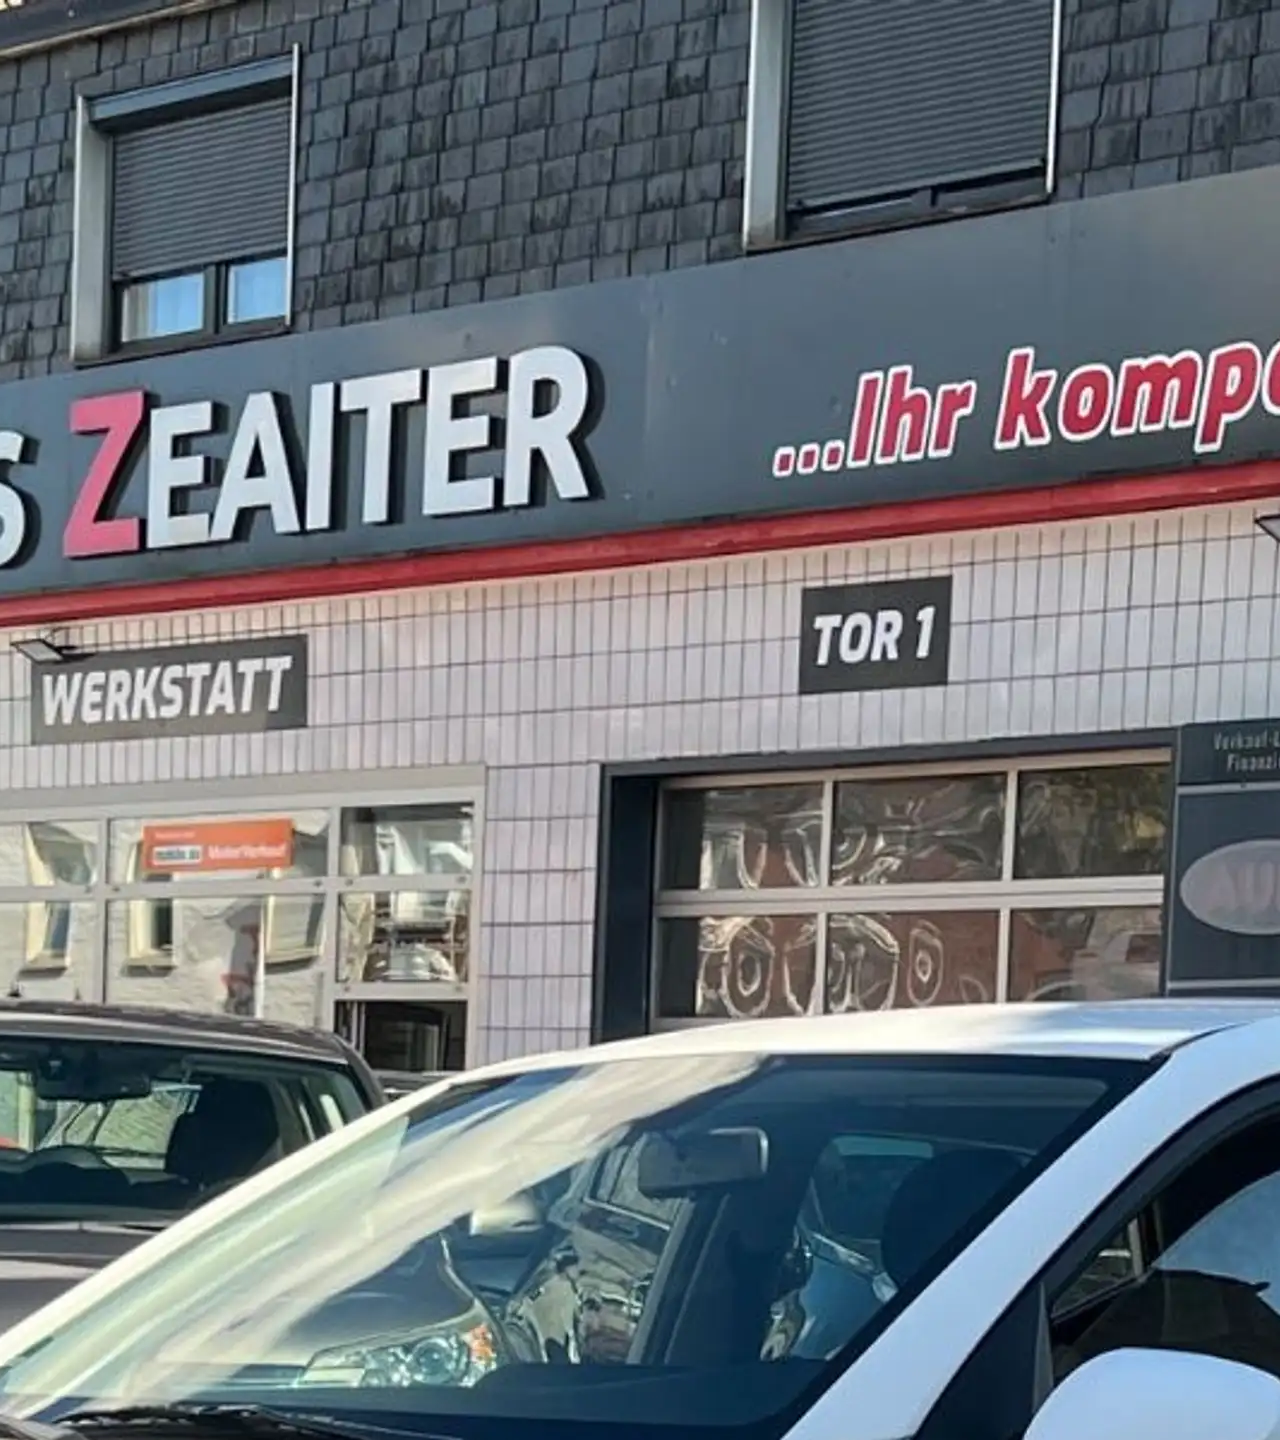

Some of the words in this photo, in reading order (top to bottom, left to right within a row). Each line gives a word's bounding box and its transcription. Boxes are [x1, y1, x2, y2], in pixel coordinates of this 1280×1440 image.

[62, 345, 594, 558] ZEAITER
[773, 362, 976, 478] ...Ihr
[813, 610, 902, 666] TOR
[914, 605, 935, 658] 1
[41, 655, 292, 727] WERKSTATT
